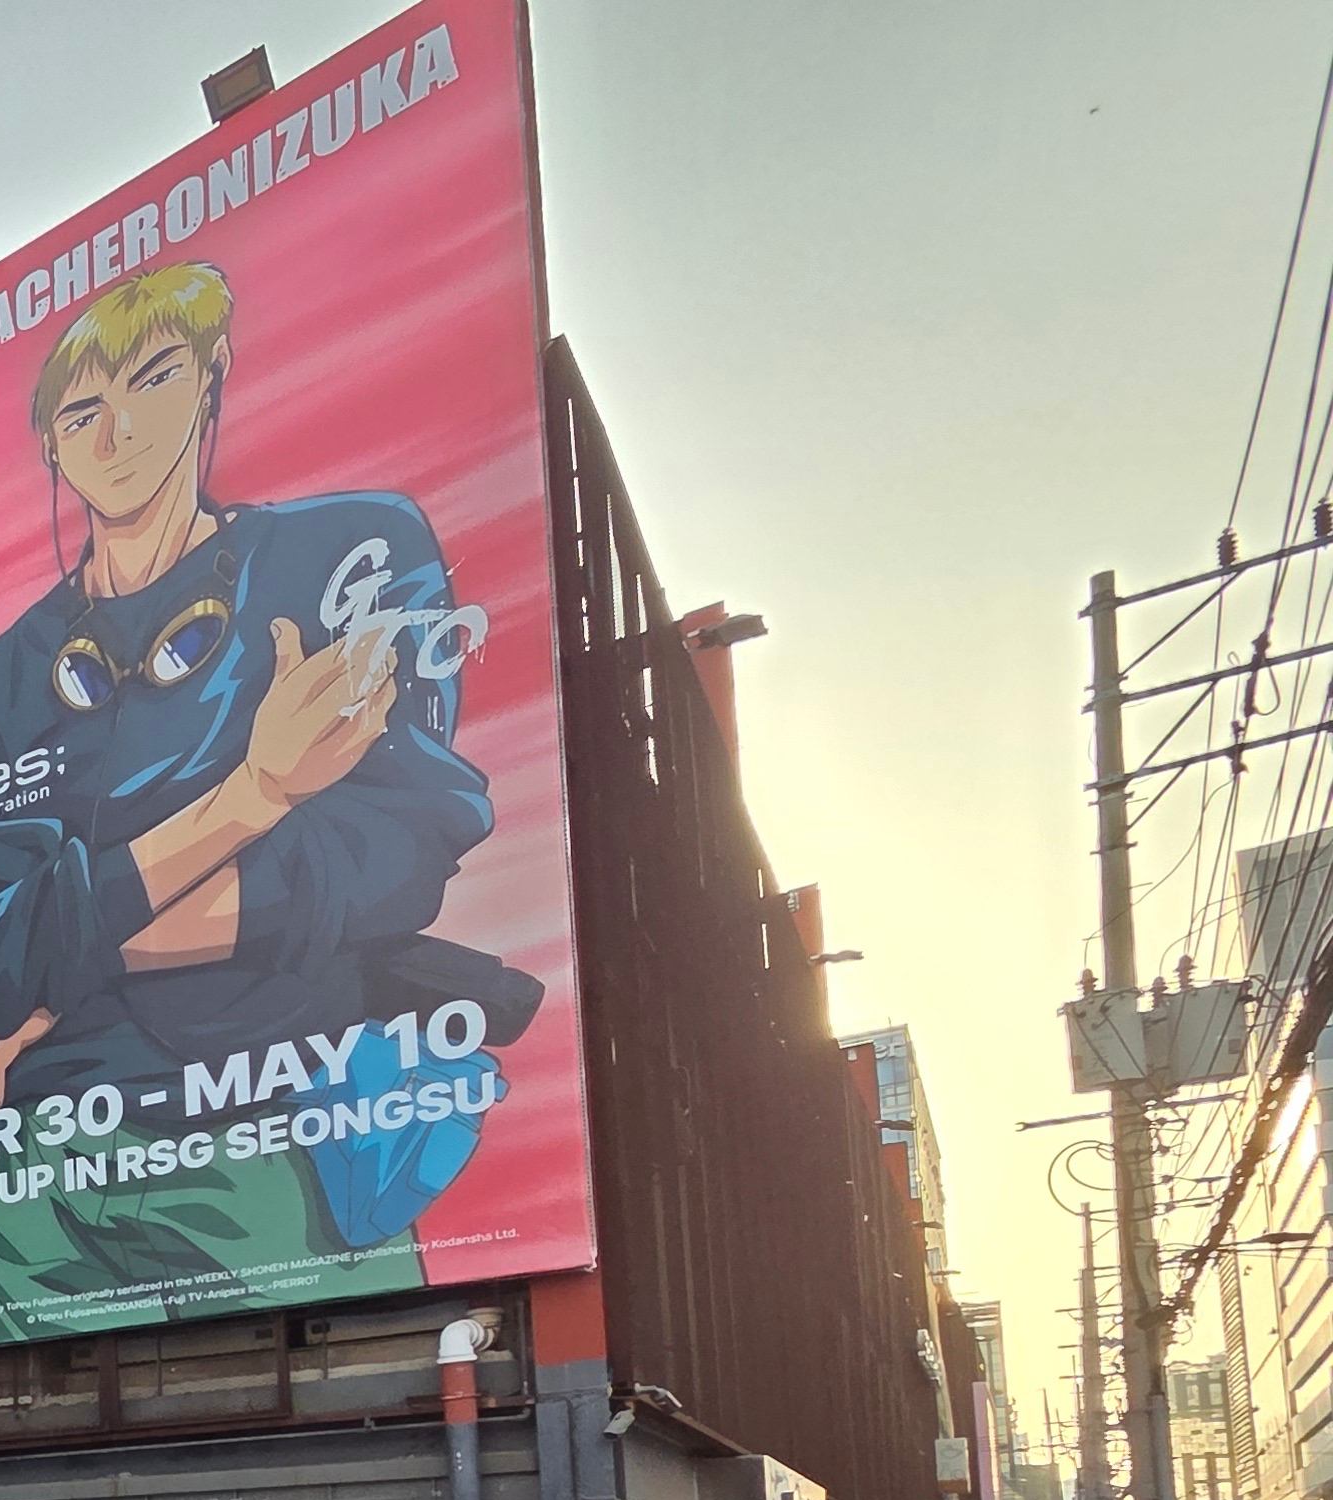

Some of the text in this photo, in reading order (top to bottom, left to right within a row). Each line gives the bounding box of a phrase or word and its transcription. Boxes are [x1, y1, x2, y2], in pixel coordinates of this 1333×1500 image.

[34, 1084, 124, 1147] 30
[183, 1022, 367, 1117] MAY
[383, 999, 488, 1070] 10
[63, 1152, 108, 1194] IN
[116, 1131, 215, 1180] RSG
[225, 1071, 498, 1160] SEONGSU
[6, 1300, 32, 1312] Tohru
[72, 1287, 115, 1303] originally
[116, 1280, 163, 1295] serialized
[164, 1278, 174, 1289] in
[175, 1276, 192, 1288] the
[194, 1268, 239, 1284] WEEKLY
[240, 1261, 289, 1278] SHONEN
[290, 1252, 351, 1270] MAGAZINE
[353, 1244, 411, 1263] published
[413, 1241, 429, 1254] by
[431, 1232, 493, 1250] Kodansha
[495, 1228, 521, 1241] Ltd.
[37, 1311, 64, 1323] Tohru
